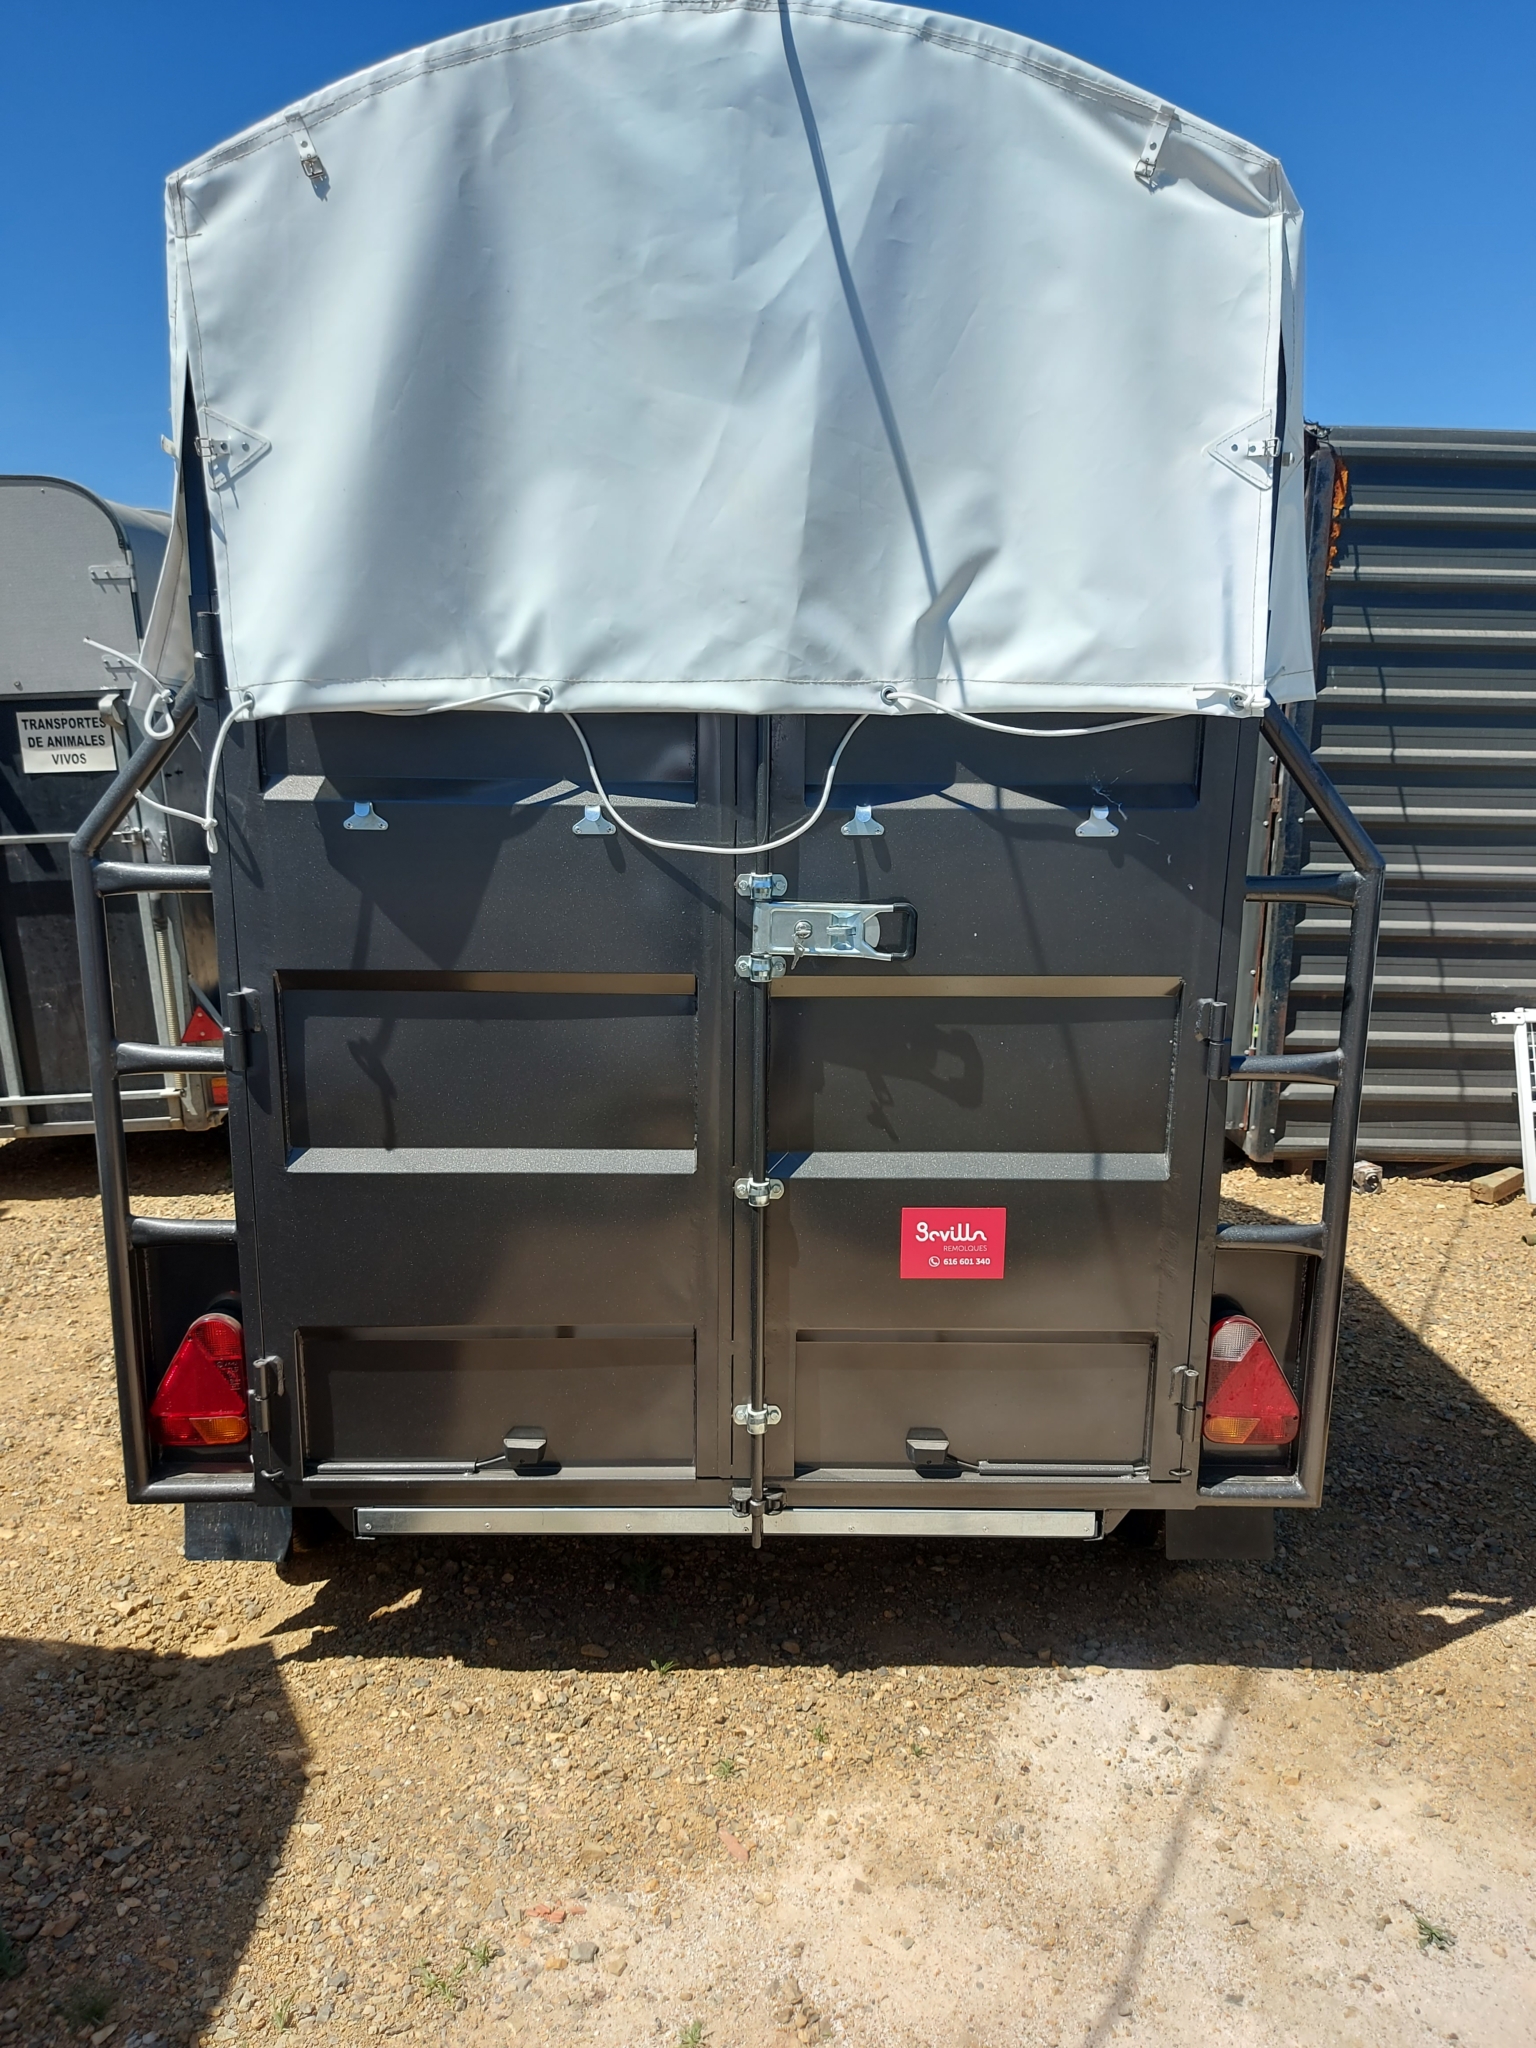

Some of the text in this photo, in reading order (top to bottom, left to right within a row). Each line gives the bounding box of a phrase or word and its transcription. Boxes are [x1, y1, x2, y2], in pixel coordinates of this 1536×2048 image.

[22, 717, 107, 730] TRANSPORTES
[27, 734, 106, 748] DE ANIMALES
[51, 753, 87, 765] VIVOS
[915, 1221, 987, 1242] Sevilla
[943, 1257, 991, 1266] 616 601 340
